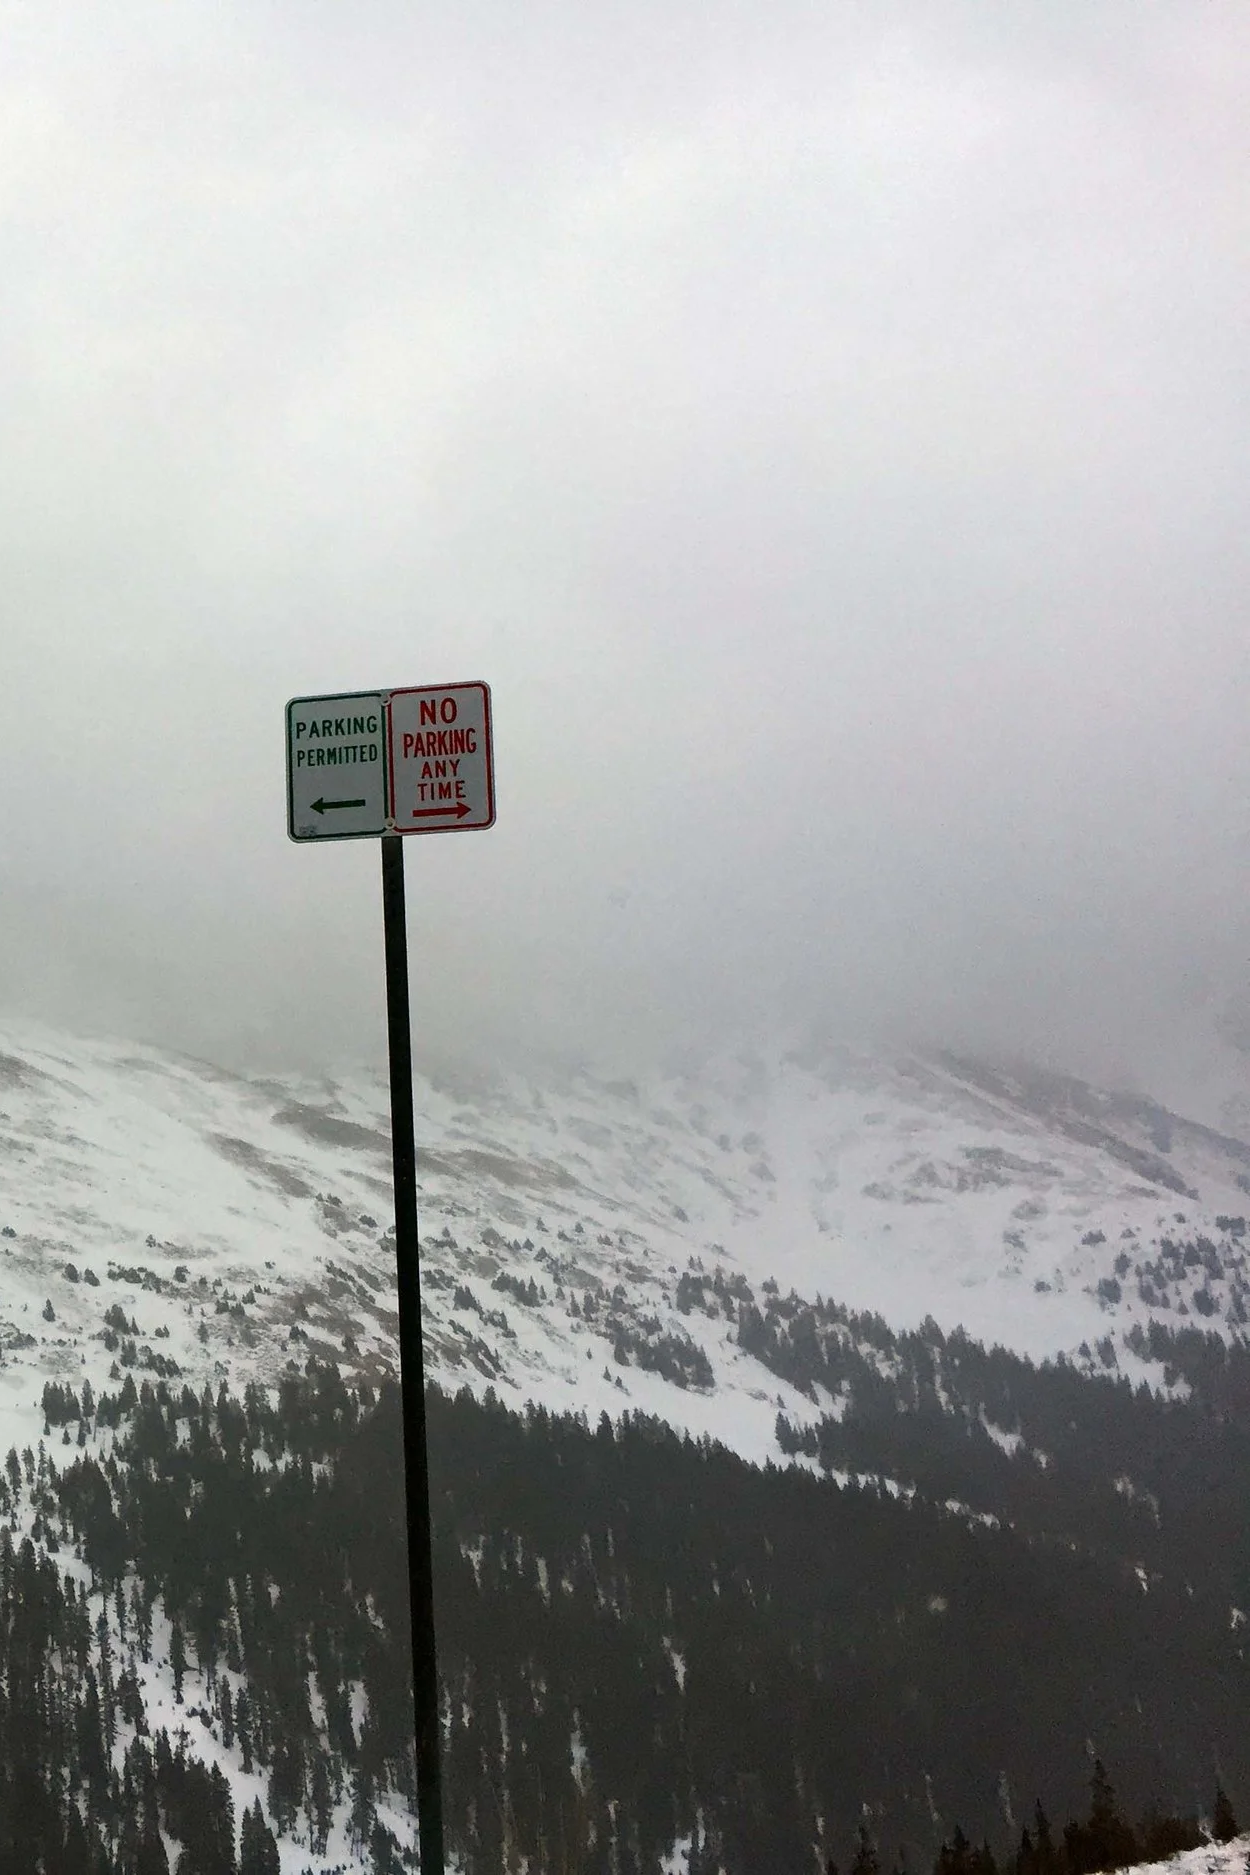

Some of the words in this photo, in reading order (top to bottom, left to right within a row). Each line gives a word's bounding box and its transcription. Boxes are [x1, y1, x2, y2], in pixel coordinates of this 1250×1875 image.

[419, 697, 458, 726] NO
[296, 715, 378, 739] PARKING
[403, 728, 477, 758] PARKING
[297, 744, 378, 767] PERMITTED
[421, 759, 460, 779] ANY
[417, 780, 466, 801] TIME
